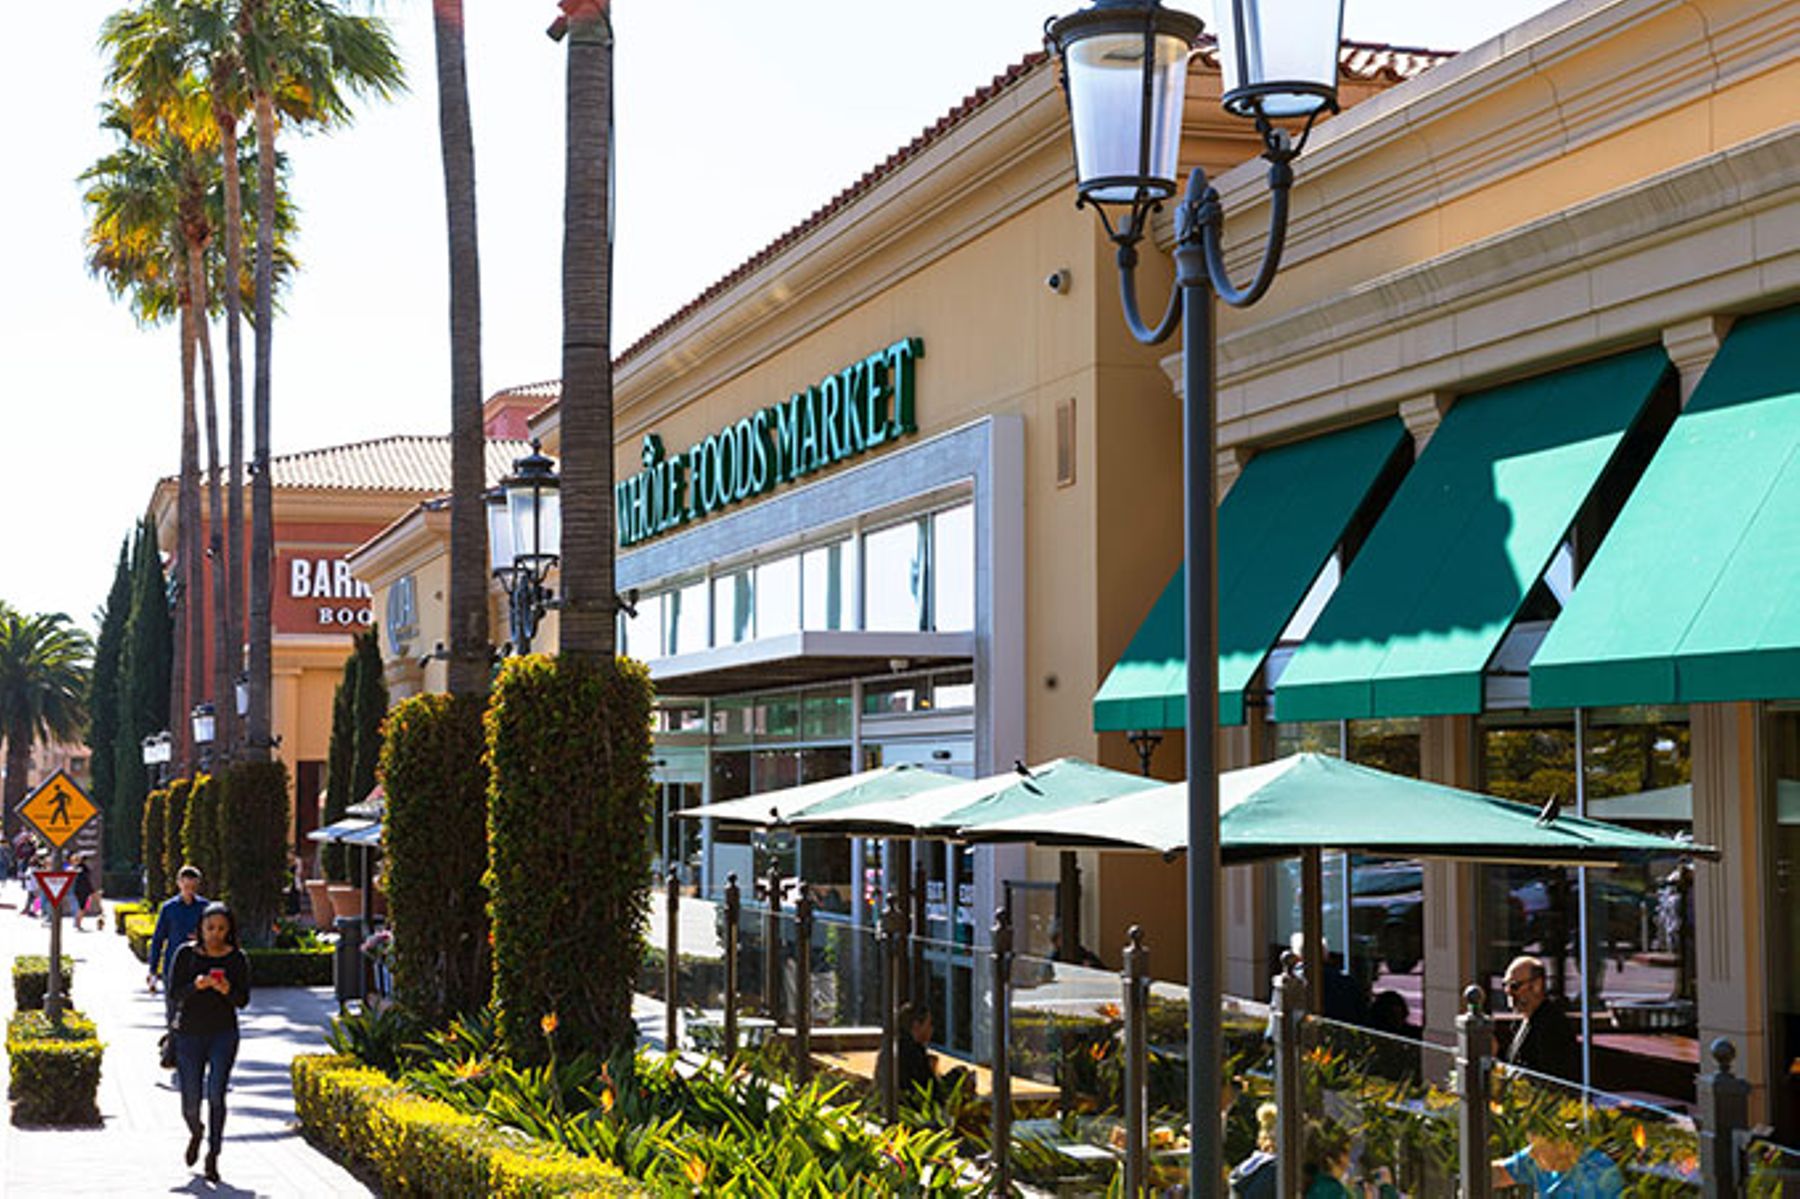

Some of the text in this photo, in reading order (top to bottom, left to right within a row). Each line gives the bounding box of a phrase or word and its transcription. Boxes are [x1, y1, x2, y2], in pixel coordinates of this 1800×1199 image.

[615, 337, 918, 546] WHOLE FOODS MARKET
